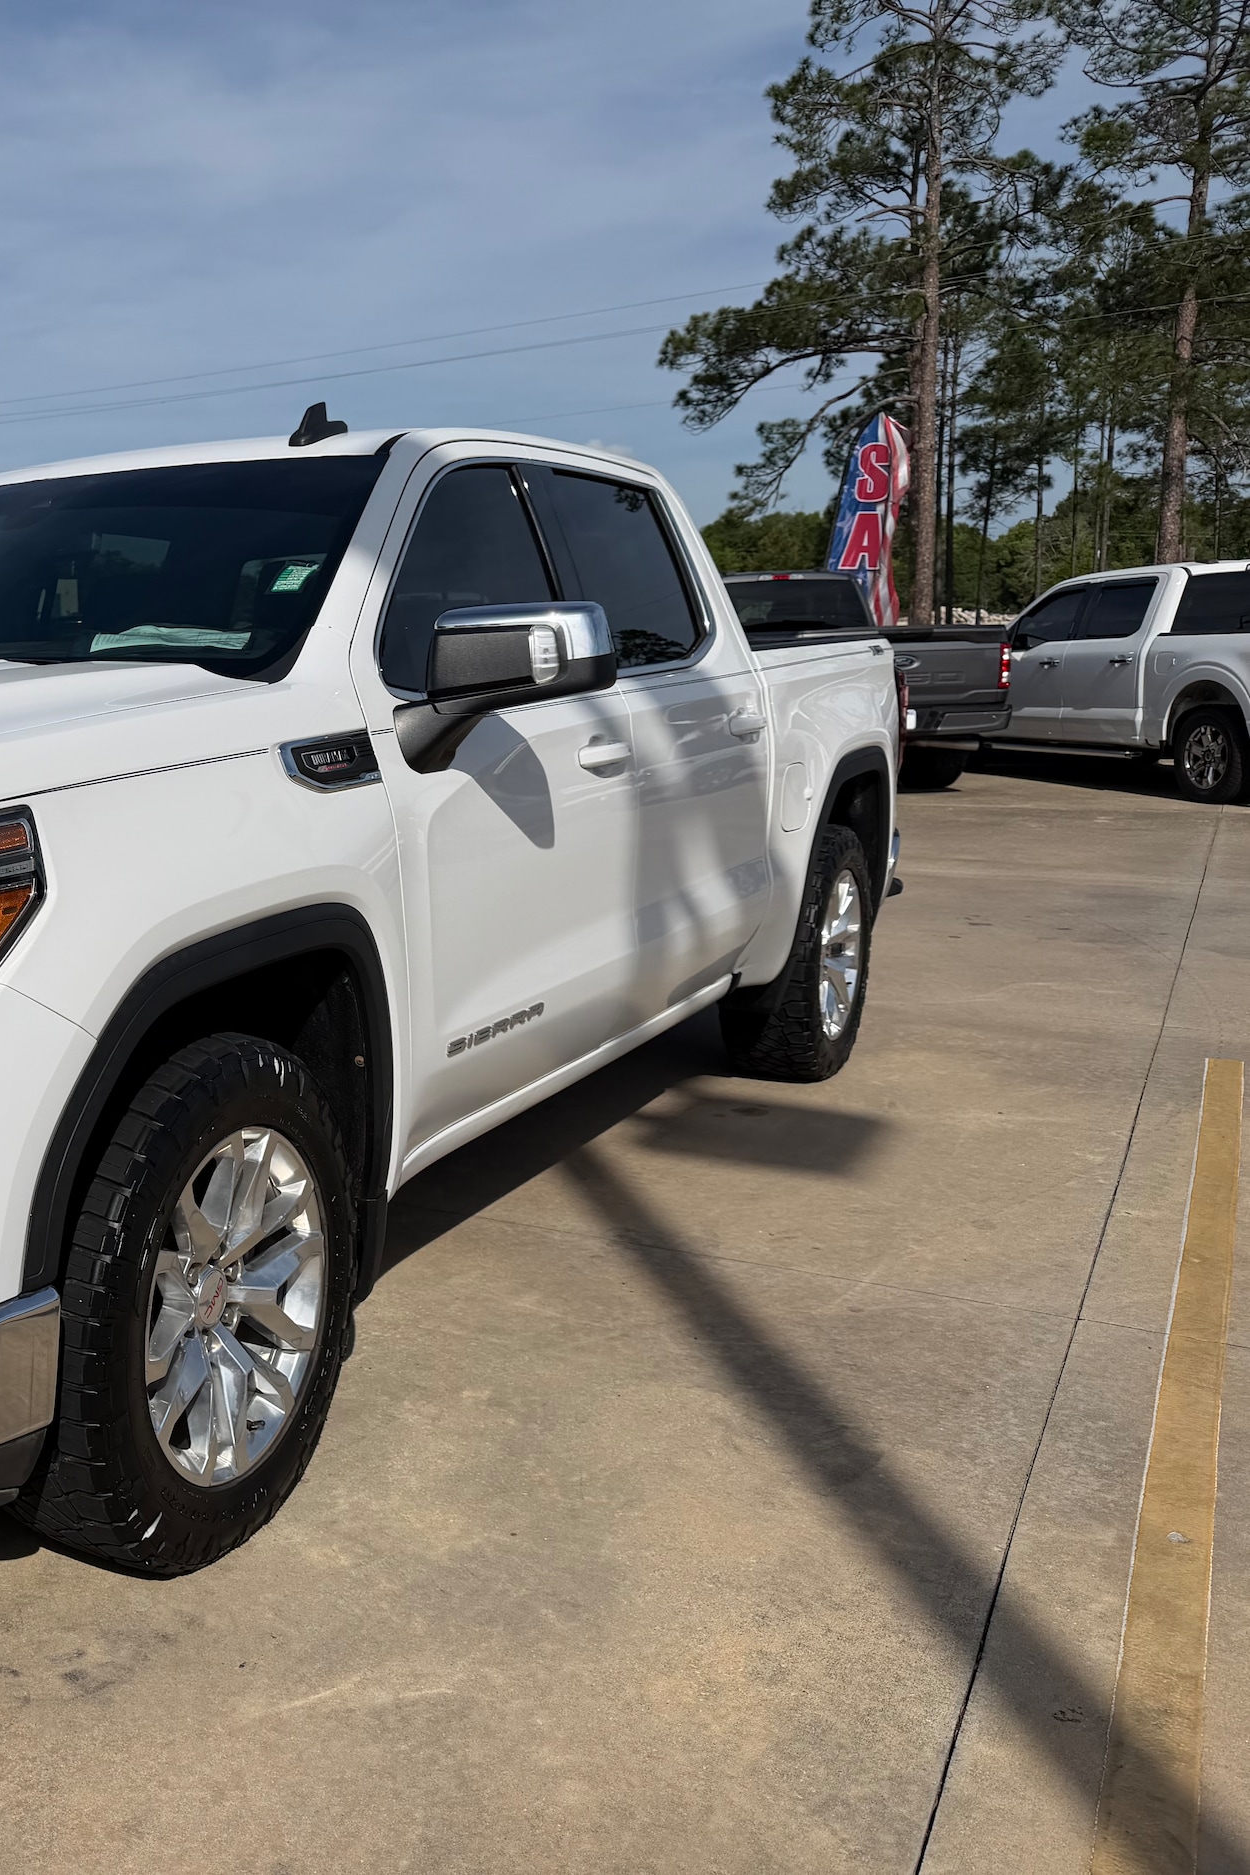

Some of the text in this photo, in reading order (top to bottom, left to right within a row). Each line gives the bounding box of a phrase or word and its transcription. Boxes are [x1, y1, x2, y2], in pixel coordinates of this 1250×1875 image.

[838, 442, 891, 570] SA
[446, 1001, 545, 1058] SIERRA
[204, 1276, 224, 1319] GMC
